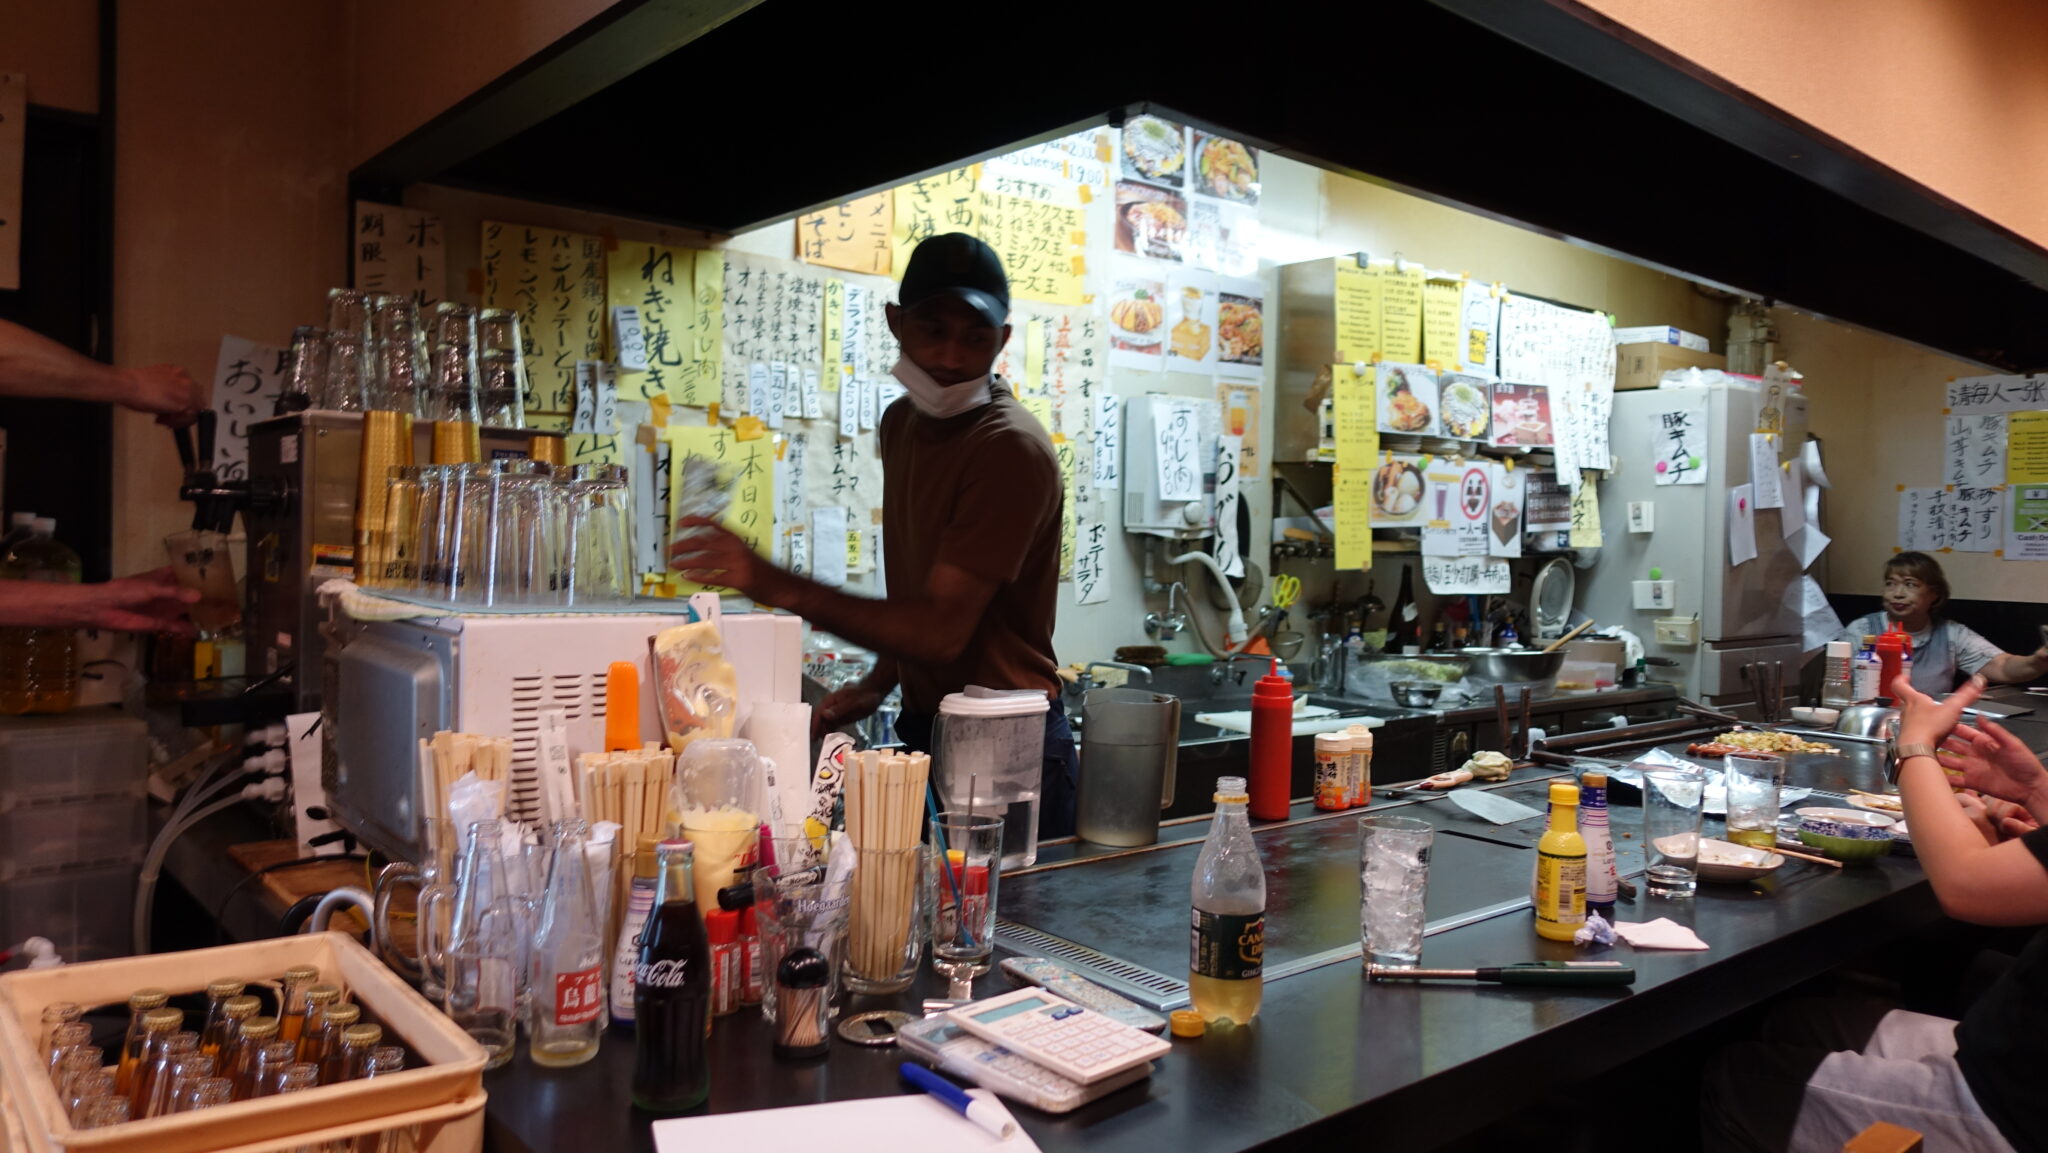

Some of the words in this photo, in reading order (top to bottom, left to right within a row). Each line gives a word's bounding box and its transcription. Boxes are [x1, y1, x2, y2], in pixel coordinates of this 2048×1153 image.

[996, 177, 1056, 200] おすすめ
[869, 192, 889, 271] メニュー
[1662, 411, 1693, 484] 豚キムチ
